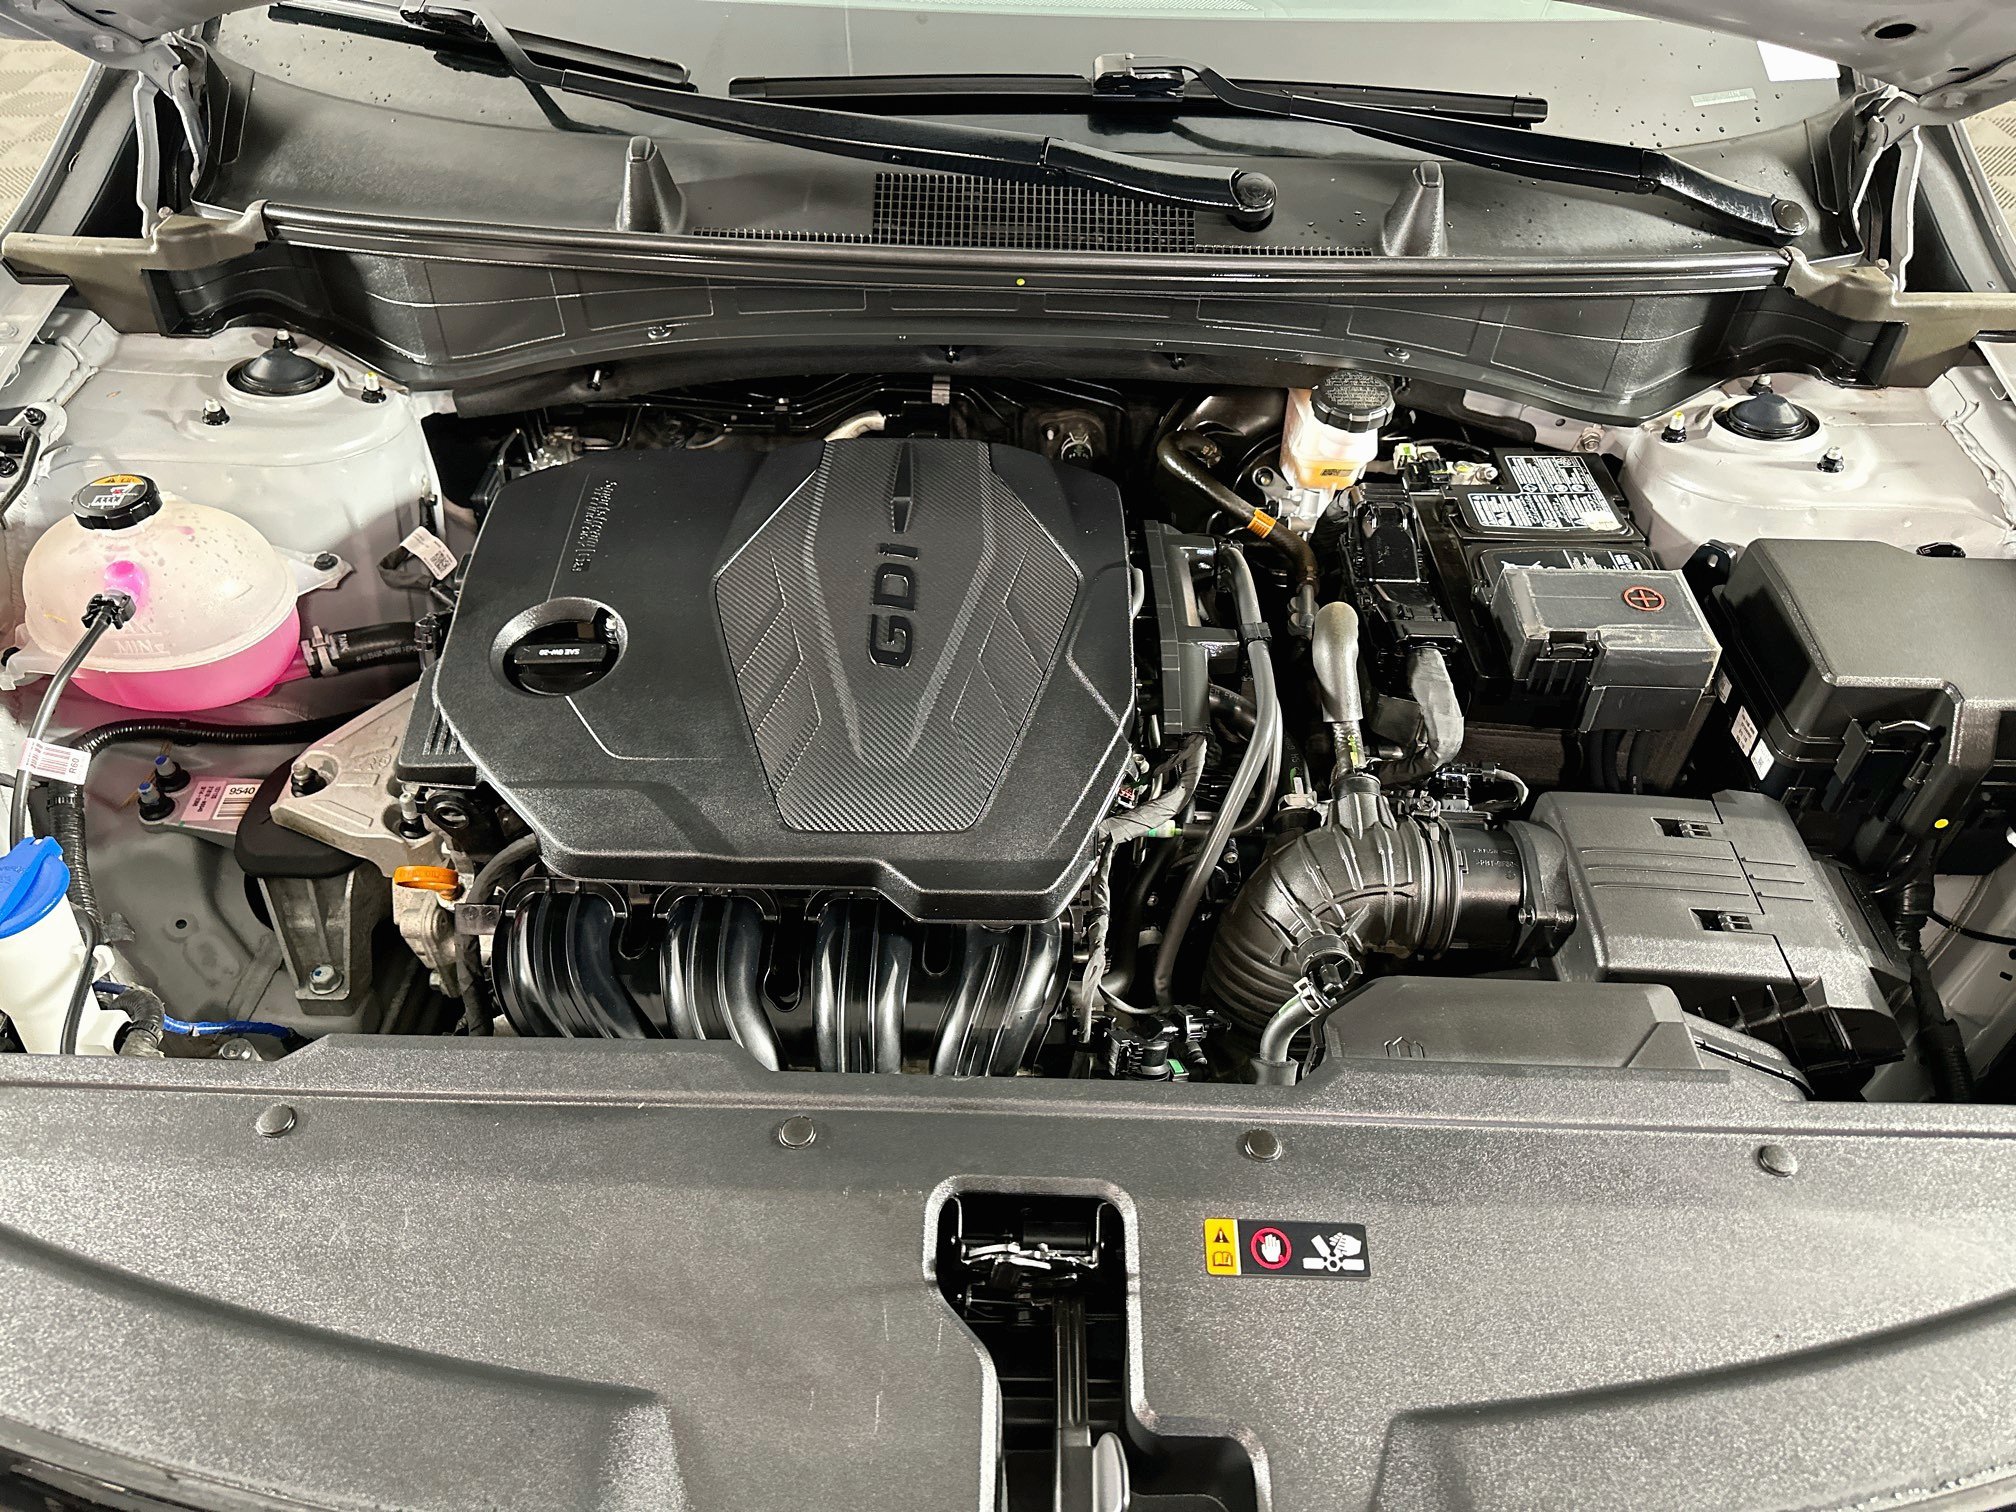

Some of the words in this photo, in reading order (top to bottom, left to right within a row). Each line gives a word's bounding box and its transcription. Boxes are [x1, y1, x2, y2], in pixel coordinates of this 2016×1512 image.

[113, 639, 153, 653] MIN
[538, 648, 563, 656] 0W-20
[229, 786, 256, 795] 9540
